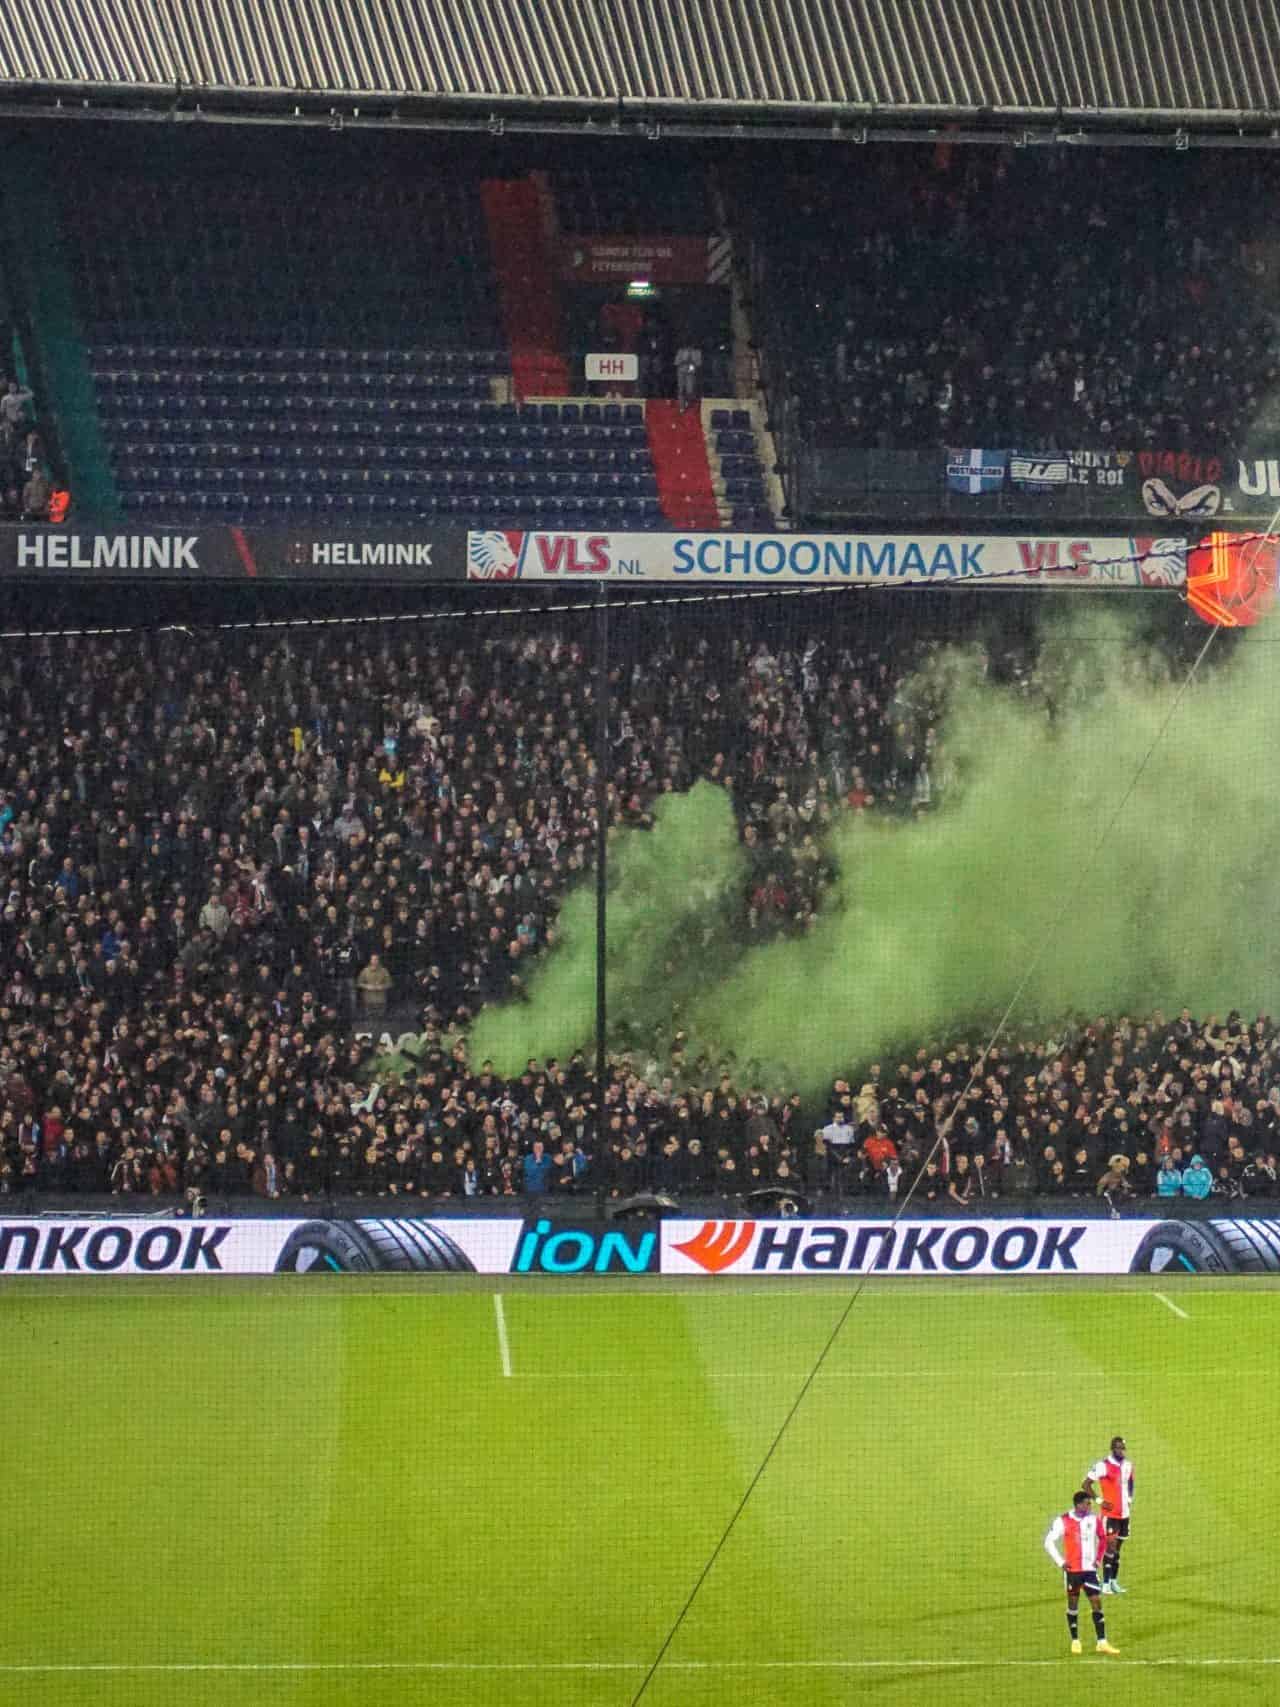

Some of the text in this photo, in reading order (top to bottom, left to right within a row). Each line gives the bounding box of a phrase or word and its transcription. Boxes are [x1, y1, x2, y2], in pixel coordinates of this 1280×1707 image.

[599, 359, 624, 375] HH
[17, 534, 200, 569] HELMINK
[312, 542, 433, 566] HELMINK
[672, 538, 986, 577] SCHOONMAAK
